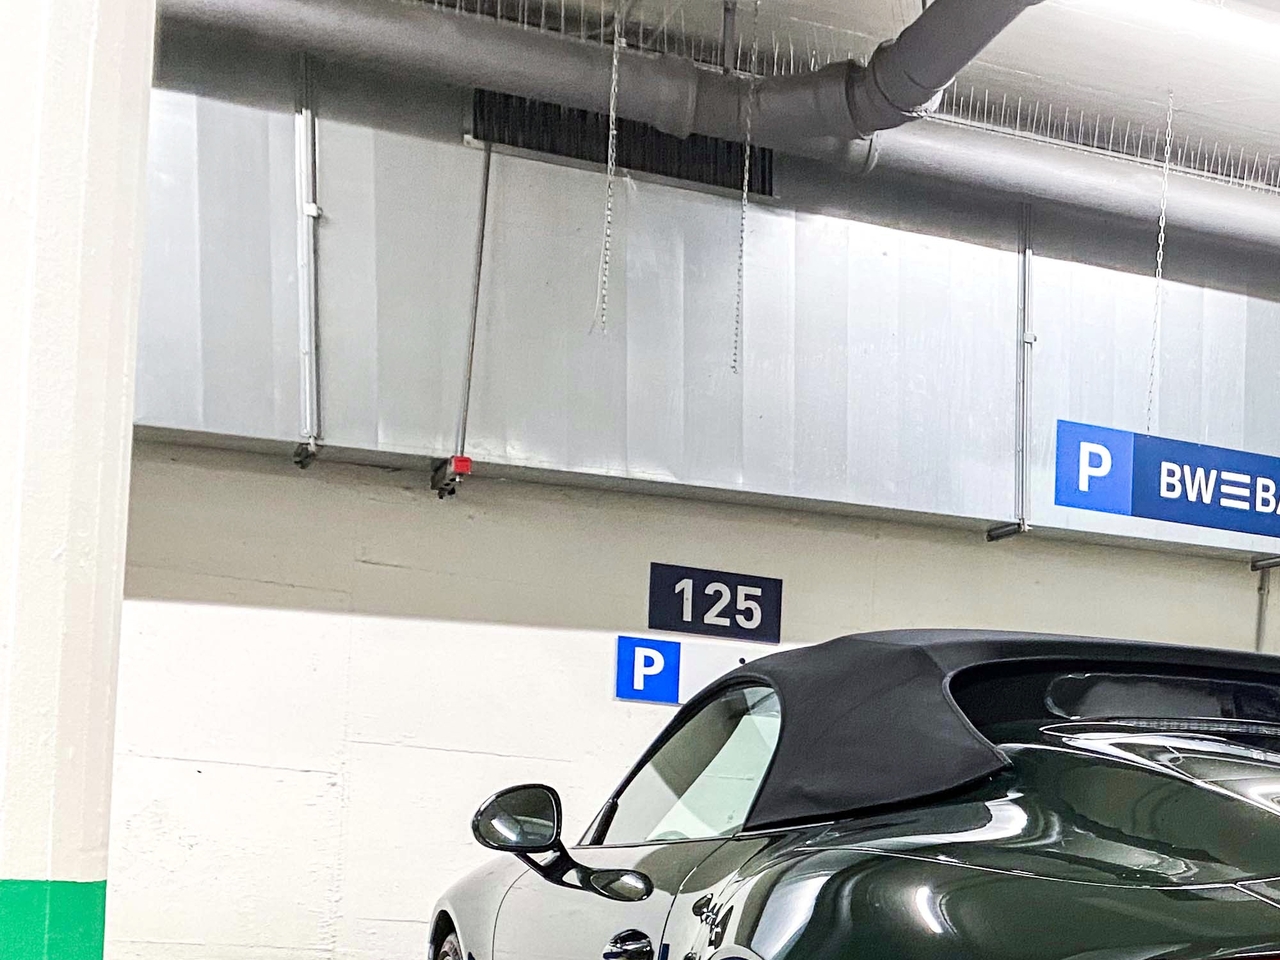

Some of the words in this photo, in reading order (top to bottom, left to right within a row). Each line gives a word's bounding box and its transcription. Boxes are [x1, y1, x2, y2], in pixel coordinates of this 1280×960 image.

[1077, 441, 1112, 492] P
[674, 578, 762, 629] 125
[633, 646, 665, 691] P
